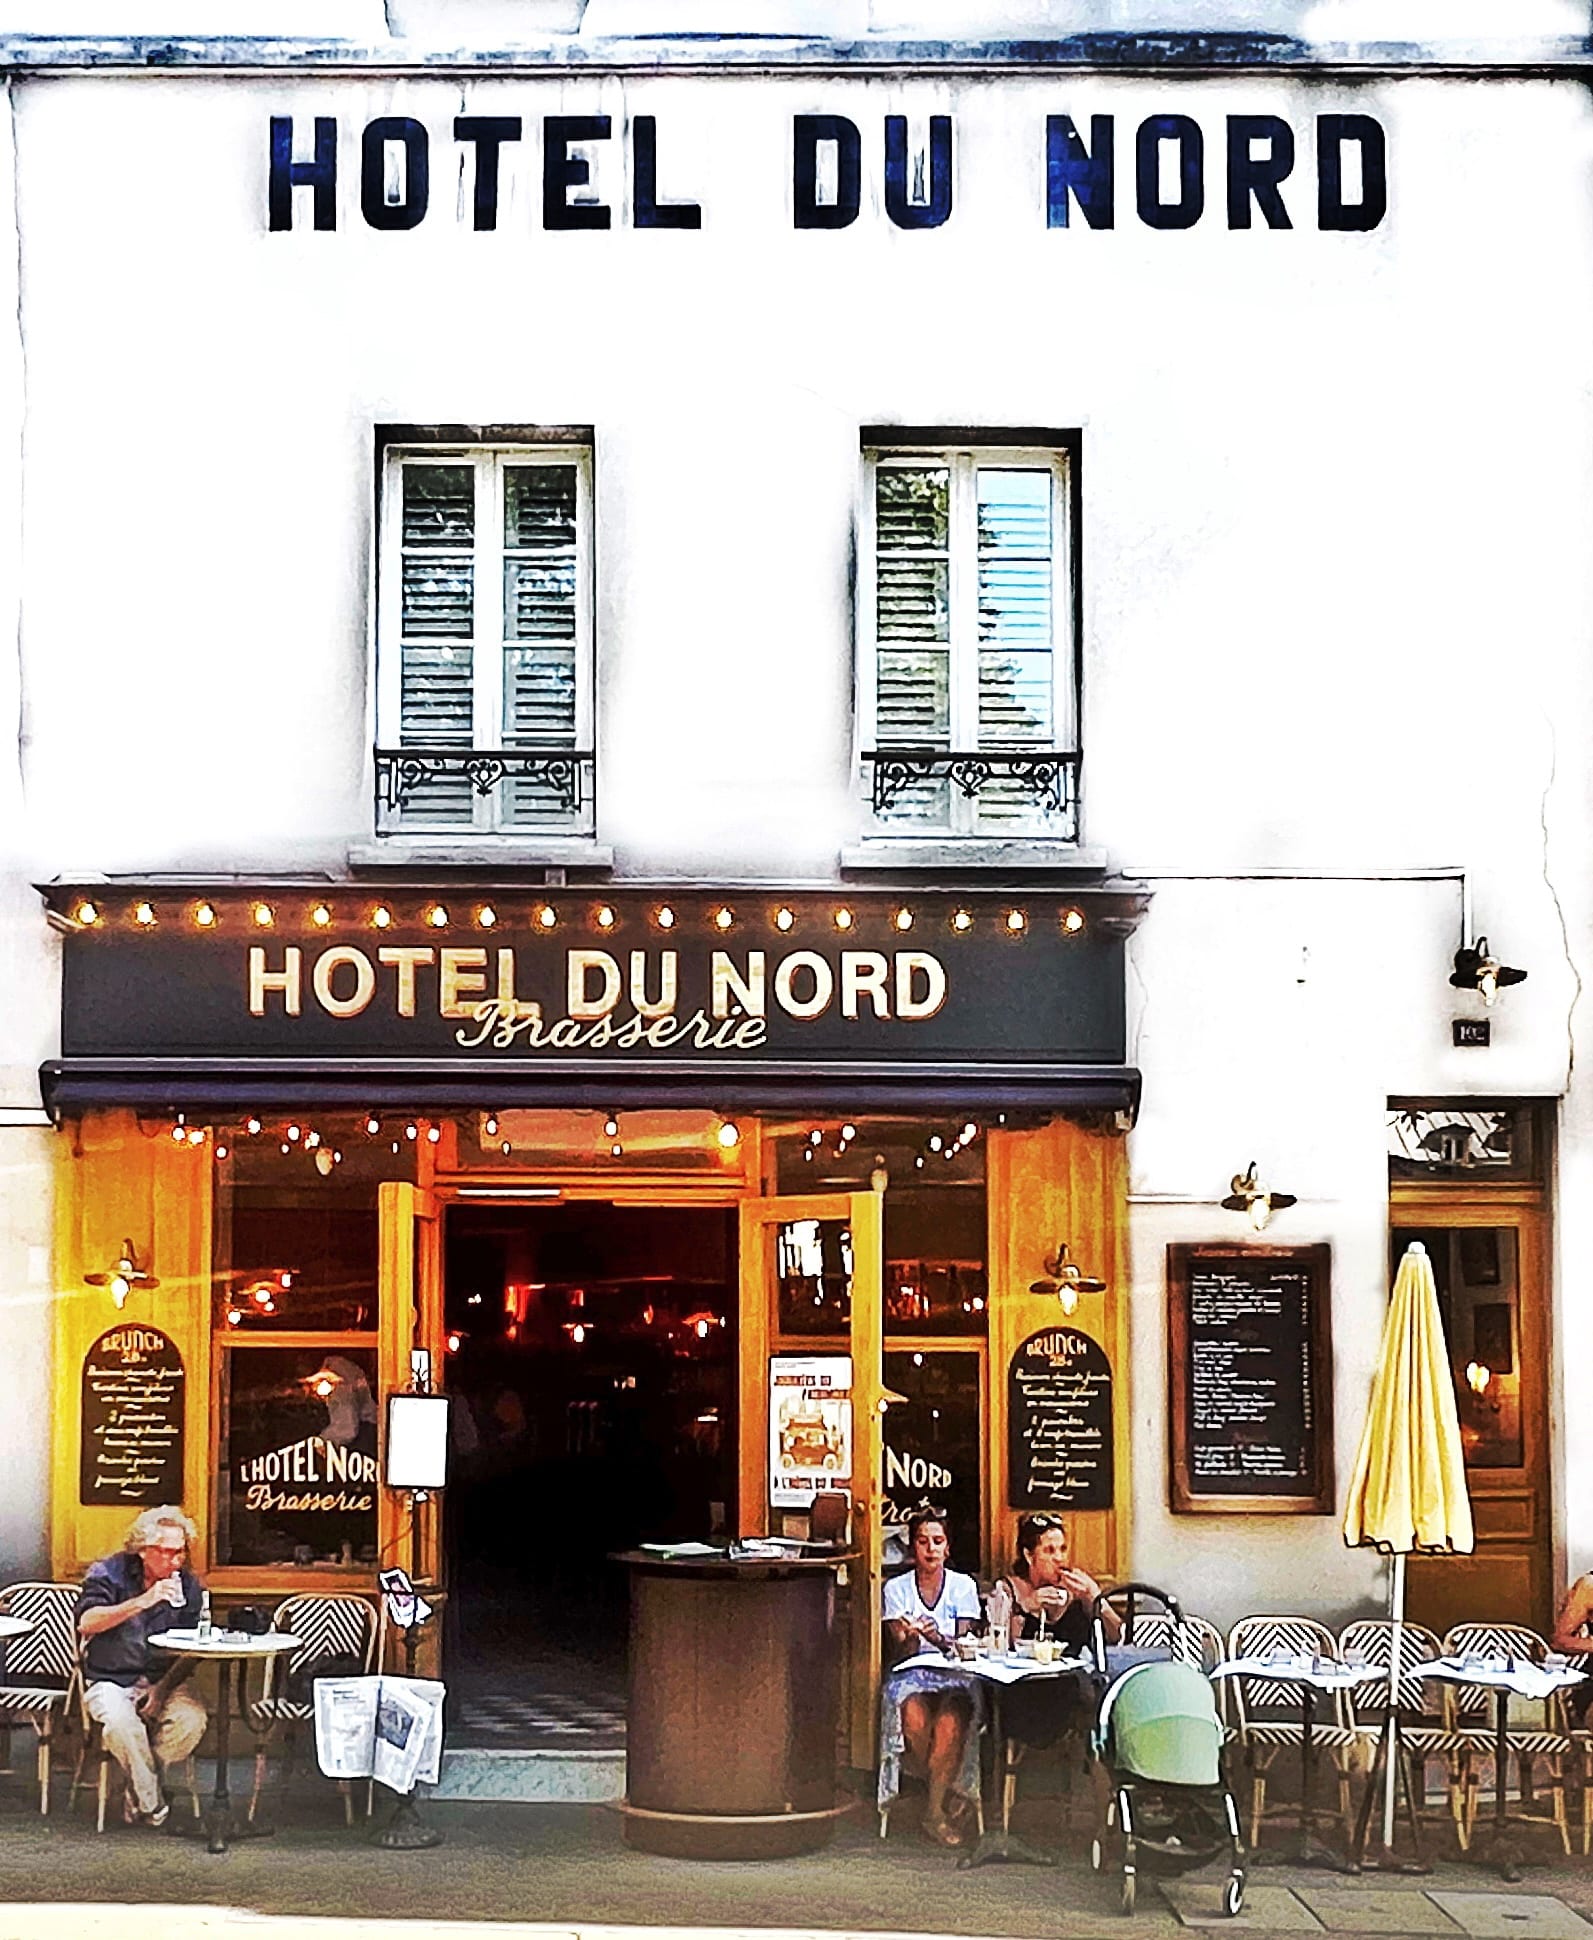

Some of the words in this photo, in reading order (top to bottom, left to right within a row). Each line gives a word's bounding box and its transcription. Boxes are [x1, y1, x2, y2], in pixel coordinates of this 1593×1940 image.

[269, 114, 702, 232] HOTEL
[793, 114, 953, 230] DU
[1046, 113, 1388, 232] NORD
[249, 946, 541, 1019] HOTEL
[567, 949, 679, 1021] DU
[711, 949, 947, 1022] NORD
[455, 998, 767, 1049] Brasserie
[101, 1329, 164, 1353] BRUNCH
[1026, 1333, 1087, 1357] BRUNCH
[886, 1445, 952, 1489] NORD
[245, 1483, 373, 1512] Brasserie
